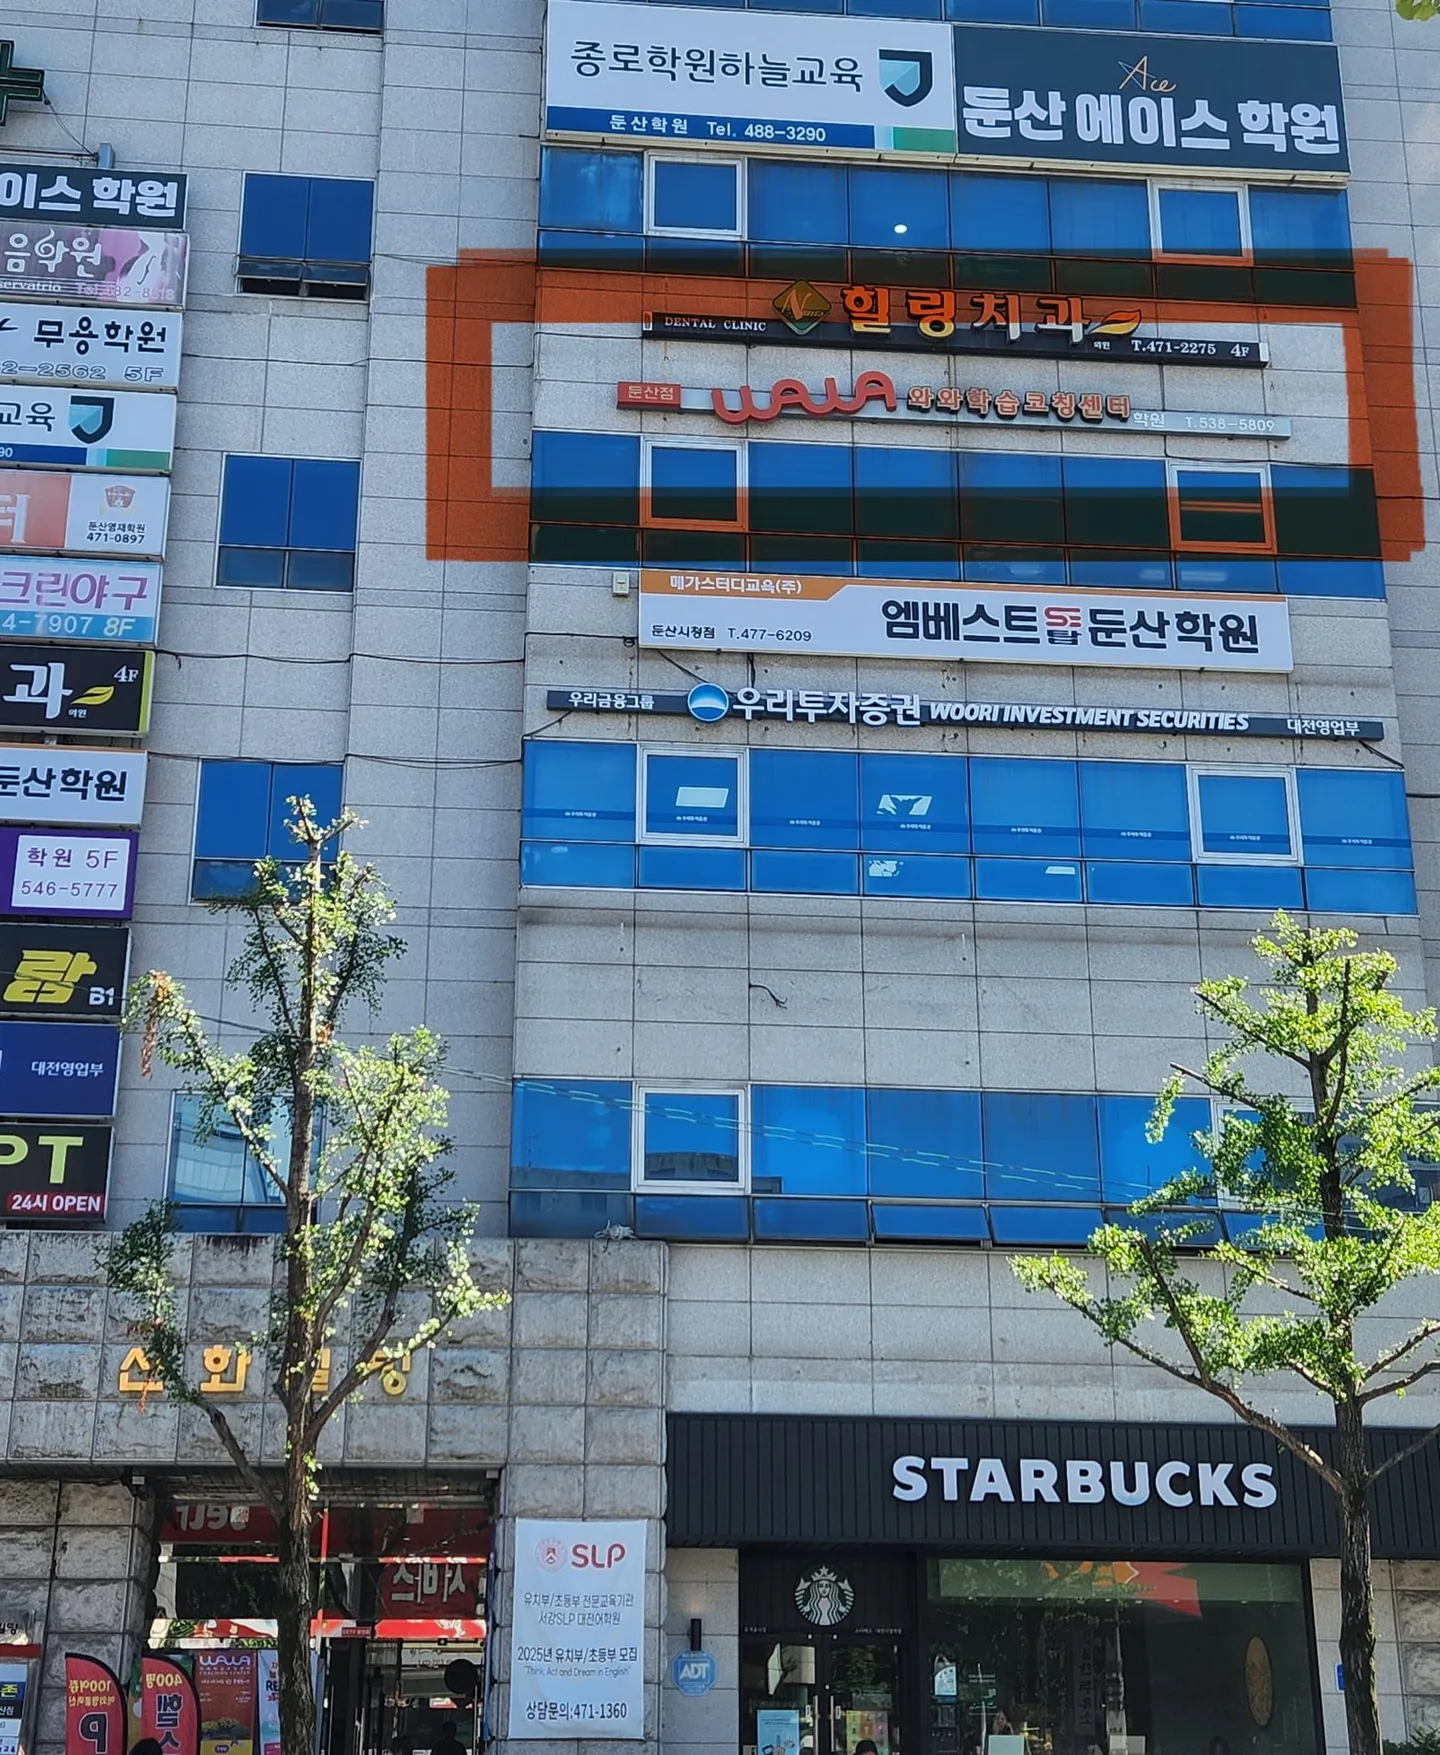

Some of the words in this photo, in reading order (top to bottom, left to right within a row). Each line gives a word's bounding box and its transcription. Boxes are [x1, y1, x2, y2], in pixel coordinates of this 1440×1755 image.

[570, 40, 864, 93] 종로학원하늘교육
[1118, 55, 1176, 92] Ace
[609, 114, 689, 135] 둔산학원
[707, 121, 737, 138] Tel.
[744, 121, 827, 143] 488-3290
[962, 85, 1067, 141] 둔산
[1075, 93, 1231, 150] 에이스
[1237, 99, 1342, 155] 학원
[92, 176, 179, 218] 학원
[664, 315, 717, 329] DENTAL
[723, 319, 767, 332] CLINIC
[841, 285, 1091, 344] 힐링치과
[34, 316, 166, 355] 무용학원
[1131, 339, 1216, 355] T.471-2275
[1230, 343, 1250, 357] 4F
[124, 366, 164, 382] 5F
[627, 384, 674, 401] 둔산점
[907, 386, 1132, 421] 와와학습코칭센터
[1133, 411, 1166, 428] 학원
[1185, 416, 1275, 432] T.538-5809
[88, 521, 146, 533] 둔산영재학원
[86, 532, 146, 544] 471-0897
[0, 571, 148, 611] 크린야구
[670, 574, 802, 595] 메가스터디교육(주)
[2, 612, 93, 635] 4-7907
[103, 617, 136, 636] 8F
[882, 599, 1041, 645] 엠베스트
[1087, 608, 1260, 655] 둔산학원
[652, 624, 715, 640] 둔산시청점
[727, 626, 812, 642] T.477-6209
[113, 664, 140, 683] 4F
[3, 661, 74, 719] 과
[567, 691, 655, 710] 우리금융그룹
[67, 708, 87, 719] 의원
[733, 685, 922, 727] 우리투자증권
[931, 702, 1000, 722] WOORI
[1002, 704, 1133, 727] INVESTMENT
[1136, 709, 1250, 732] SECURITIES
[1286, 717, 1361, 737] 대전영업부
[27, 846, 72, 868] 학원
[85, 849, 119, 869] 5F
[21, 880, 118, 898] 546-5777
[89, 986, 115, 1006] B1
[31, 1060, 104, 1077] 대전영업부
[11, 1194, 47, 1211] 24시
[52, 1194, 100, 1212] OPEN
[892, 1454, 1278, 1508] STARBUCKS
[571, 1543, 626, 1569] SLP
[518, 1646, 552, 1662] 2025년
[555, 1647, 616, 1664] 유치부/초등부
[620, 1647, 638, 1662] 모집
[559, 1666, 573, 1677] and
[679, 1663, 710, 1680] ADT
[526, 1700, 627, 1721] 상담문의:471-1360
